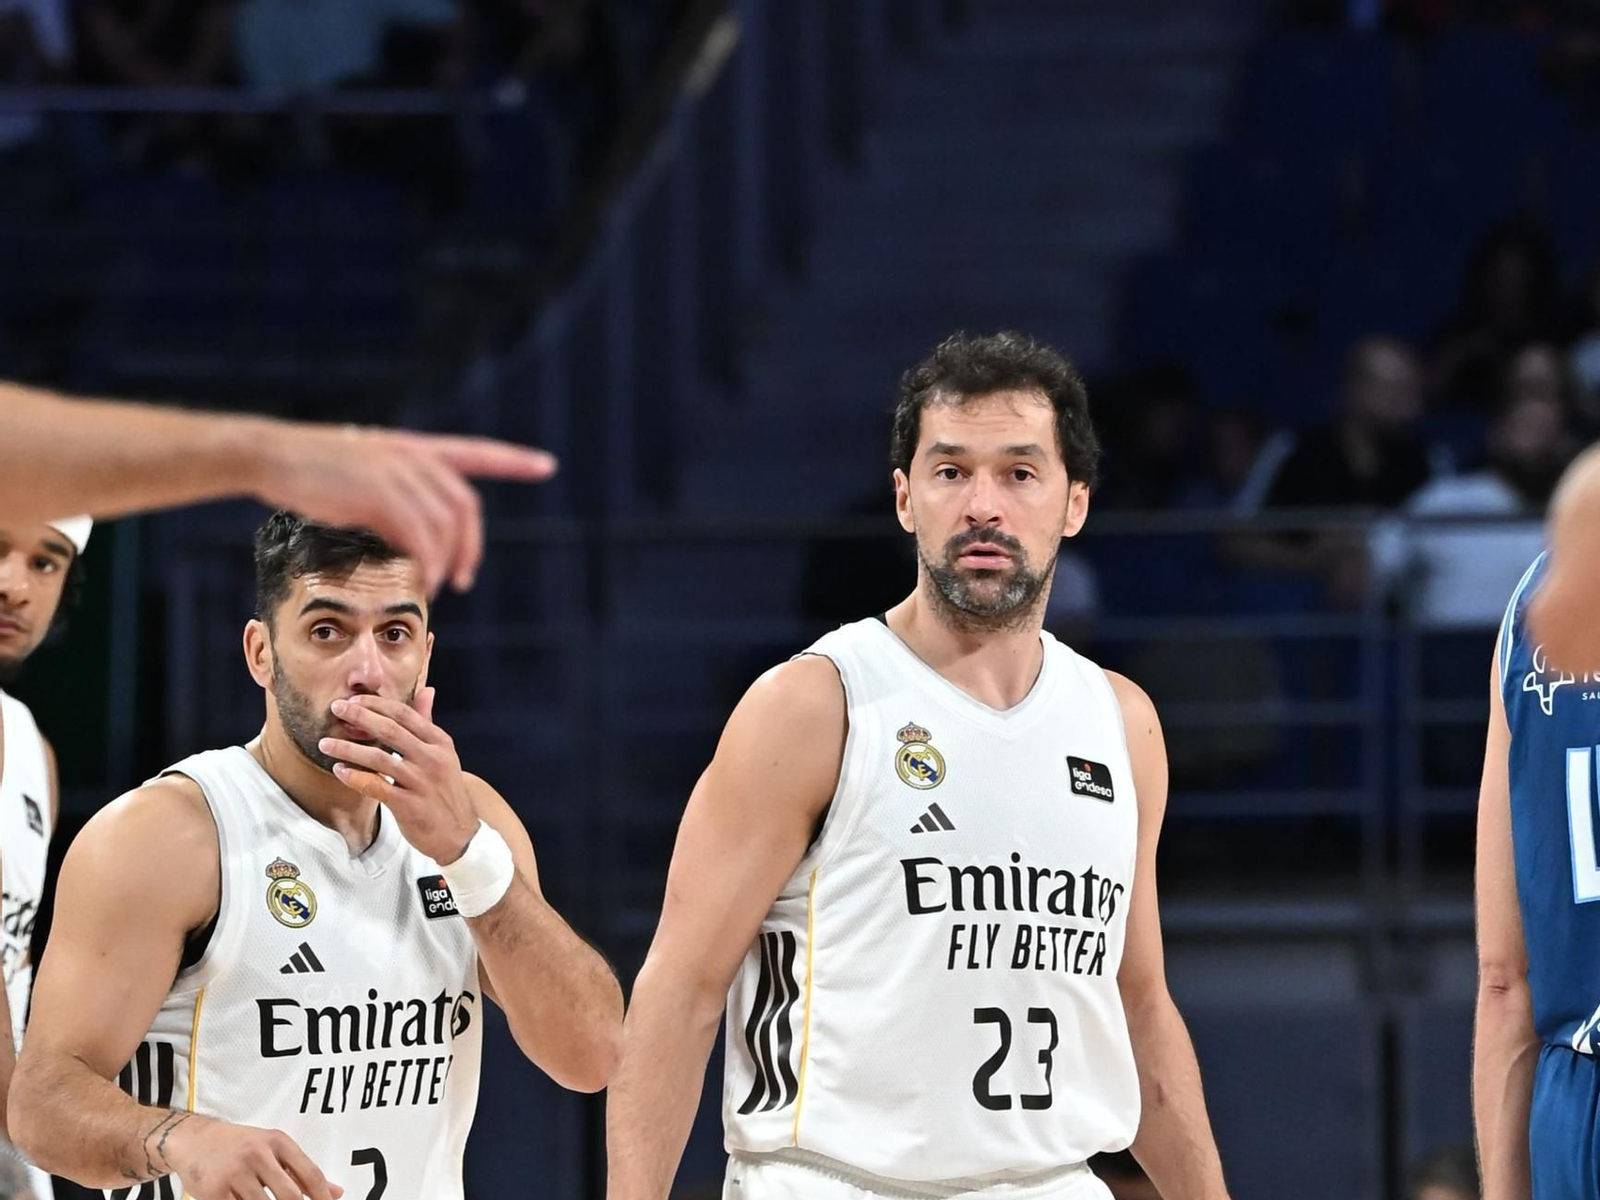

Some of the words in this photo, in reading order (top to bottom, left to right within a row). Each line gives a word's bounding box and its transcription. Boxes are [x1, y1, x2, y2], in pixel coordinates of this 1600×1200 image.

[1072, 767, 1092, 781] liga
[1074, 781, 1112, 798] endesa
[425, 888, 448, 902] liga
[900, 852, 1125, 926] Emirates
[947, 923, 1001, 970] FLY
[1010, 923, 1106, 976] BETTER
[255, 988, 475, 1057] Emirats
[299, 1065, 355, 1114] FLY
[360, 1054, 453, 1110] BETTE
[972, 1007, 1059, 1111] 23
